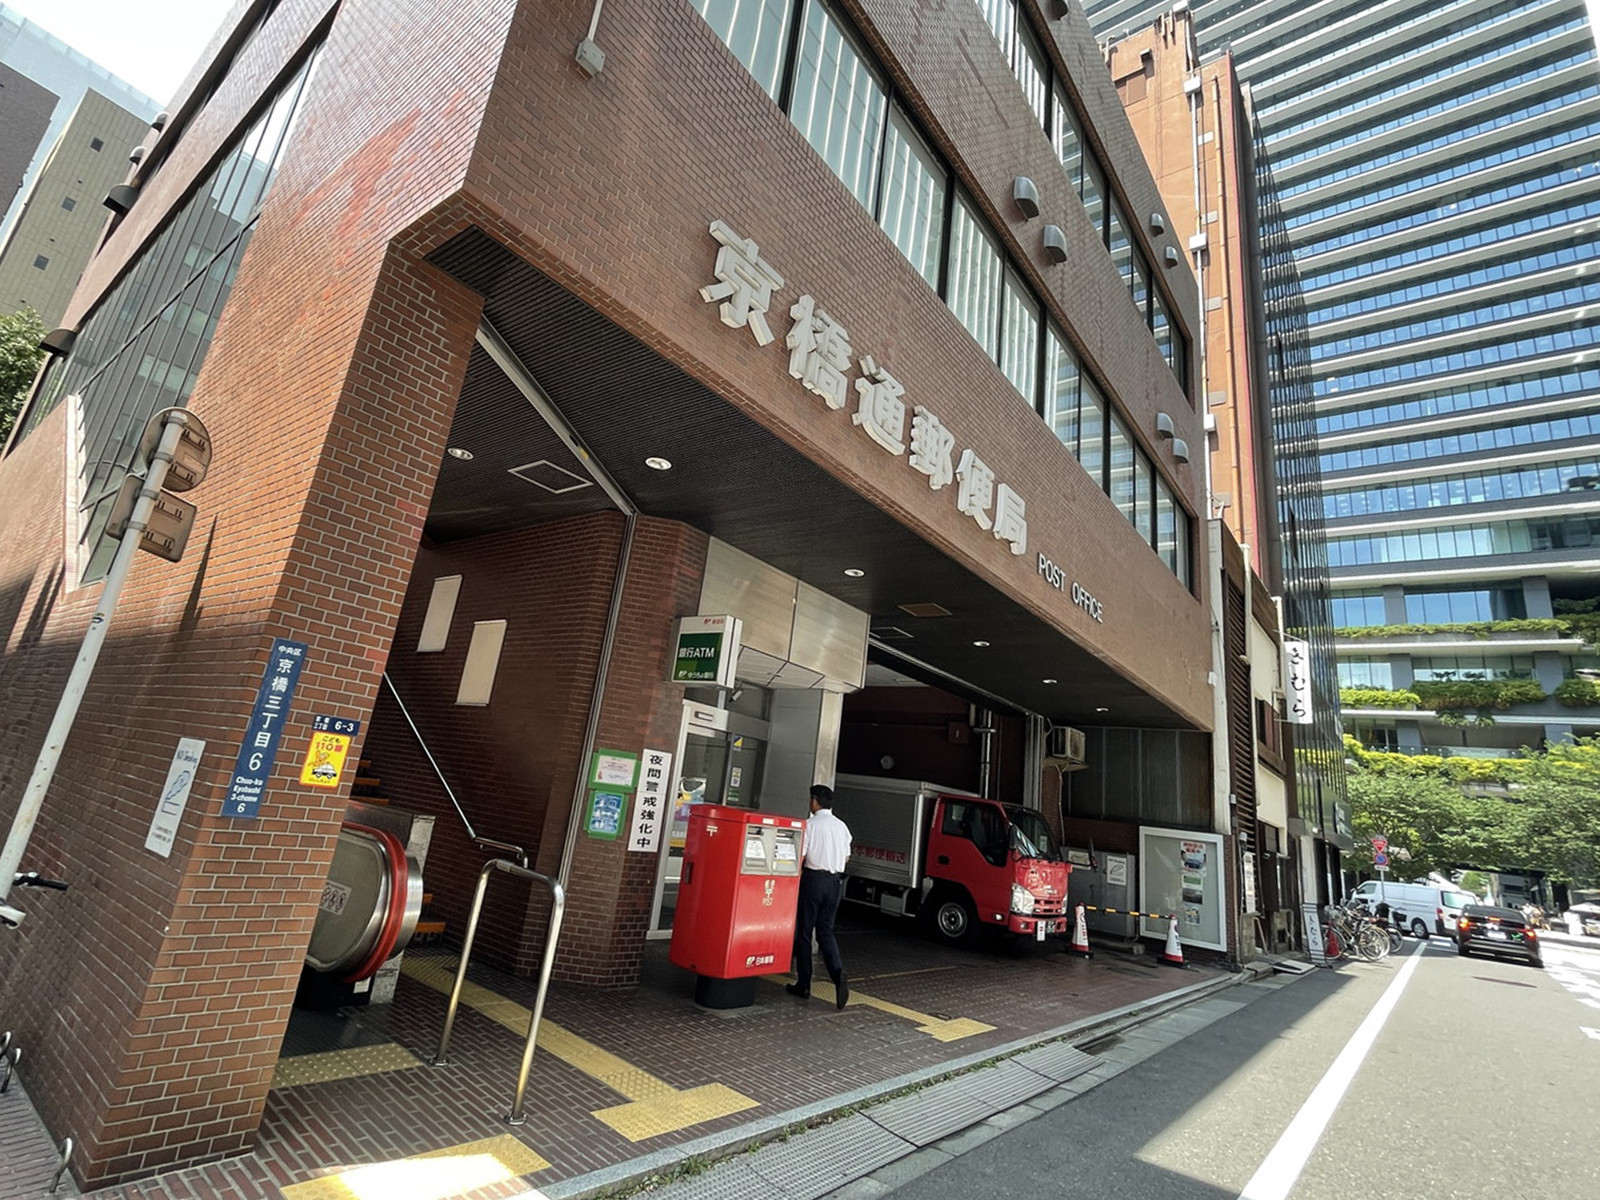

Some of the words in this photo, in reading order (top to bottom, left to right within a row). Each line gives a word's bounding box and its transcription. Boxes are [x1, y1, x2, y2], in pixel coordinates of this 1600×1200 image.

[699, 219, 1028, 556] 京橋通郵便局
[1039, 553, 1066, 592] POST
[1072, 582, 1103, 624] OFFICE
[1291, 647, 1307, 717] きむら
[334, 720, 354, 732] 6-3
[237, 802, 246, 813] 6
[851, 843, 907, 865] 本郵便輸送
